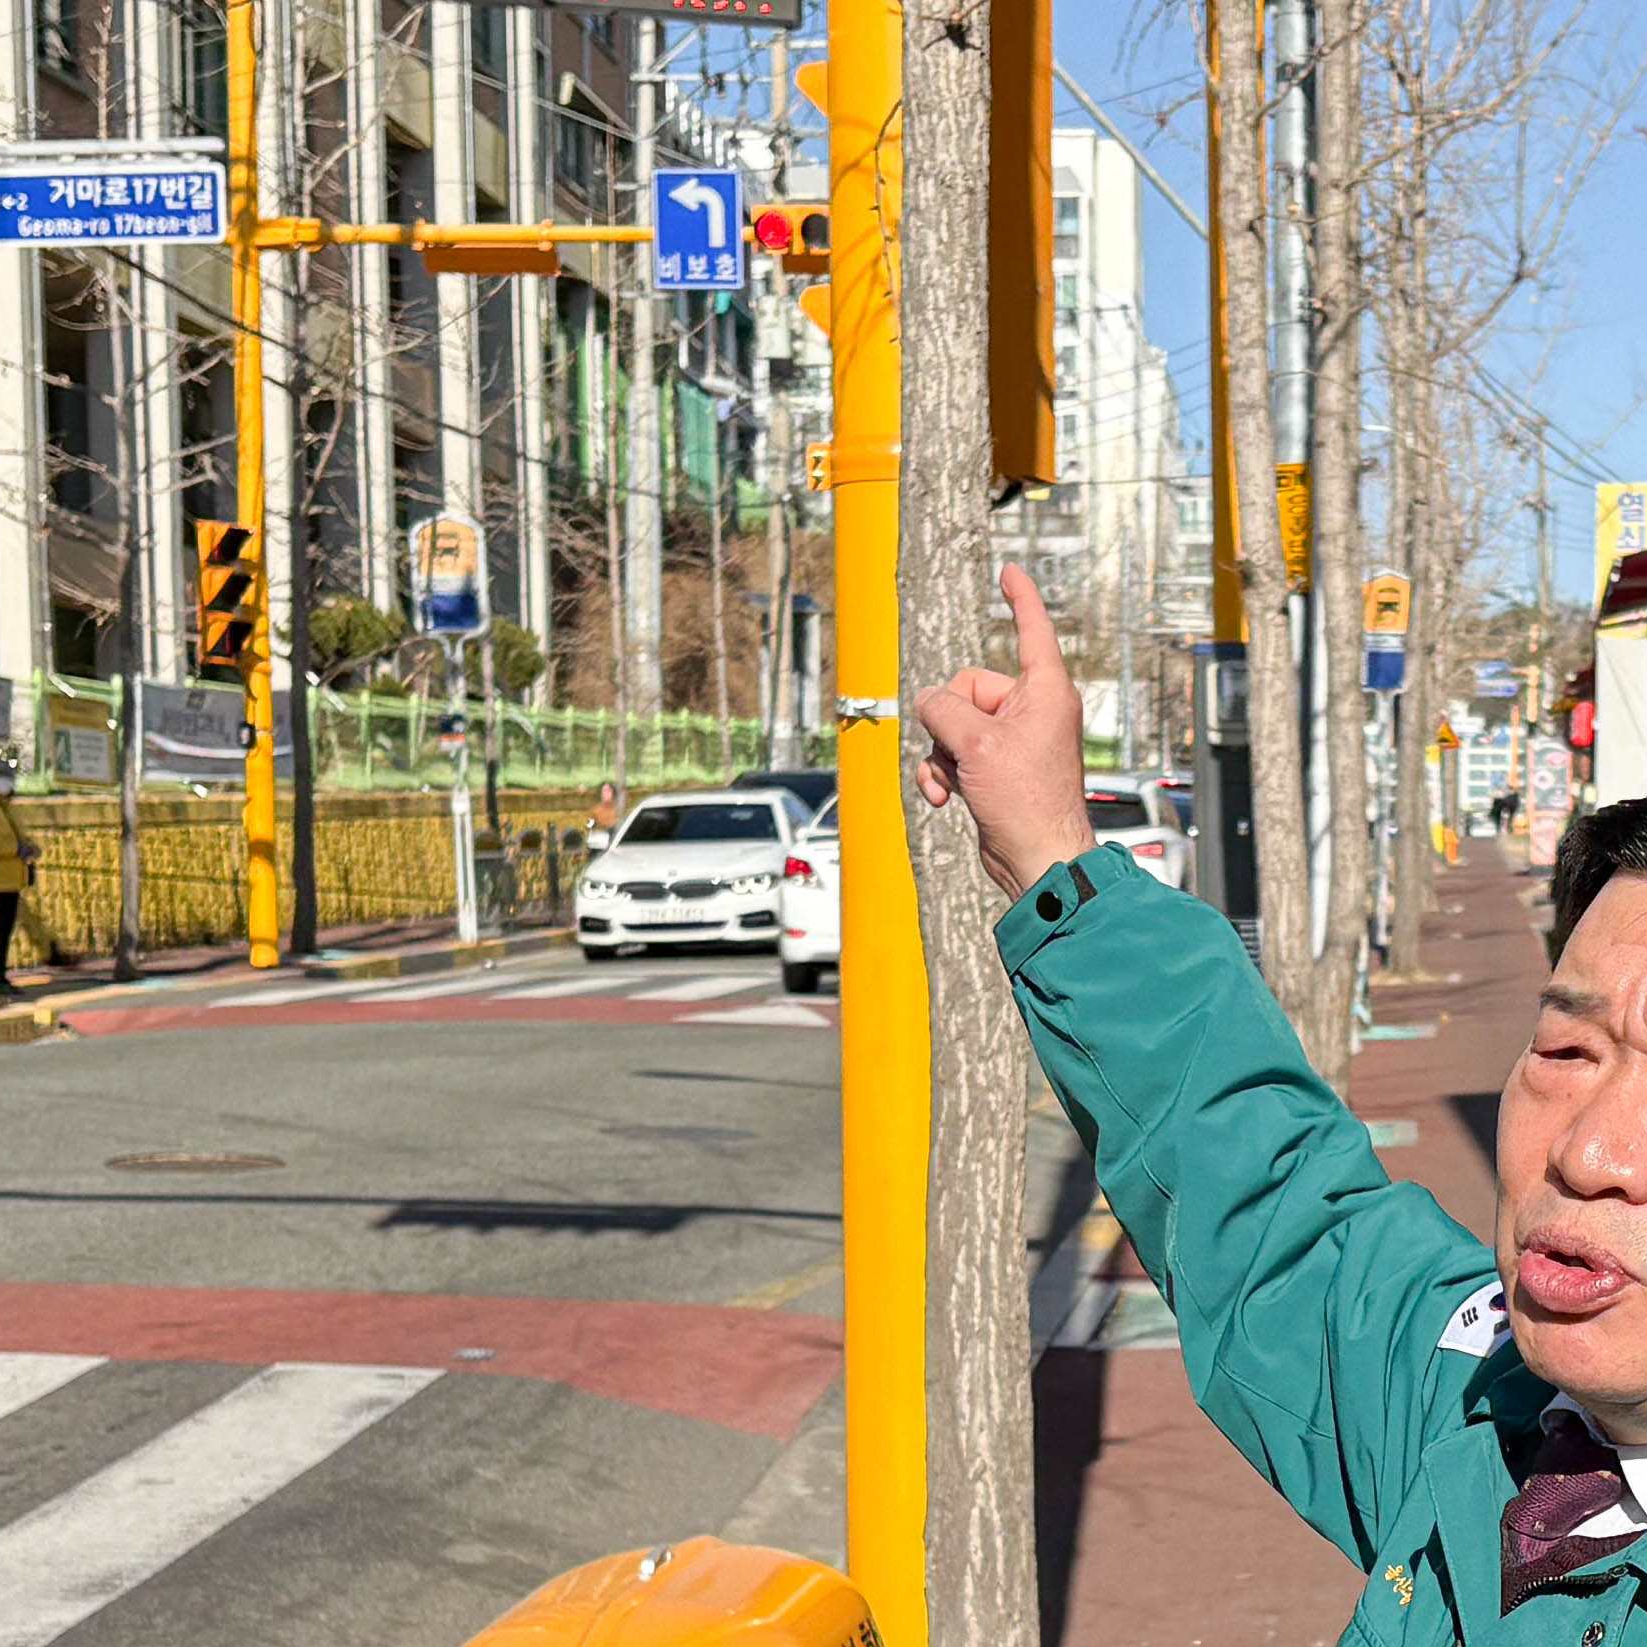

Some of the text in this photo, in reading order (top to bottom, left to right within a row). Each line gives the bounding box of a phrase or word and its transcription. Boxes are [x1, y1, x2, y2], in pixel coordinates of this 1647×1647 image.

[48, 174, 214, 211] 거마로17번길
[17, 212, 213, 238] Geoma-ro 17beon-gil
[659, 252, 737, 282] 비보호
